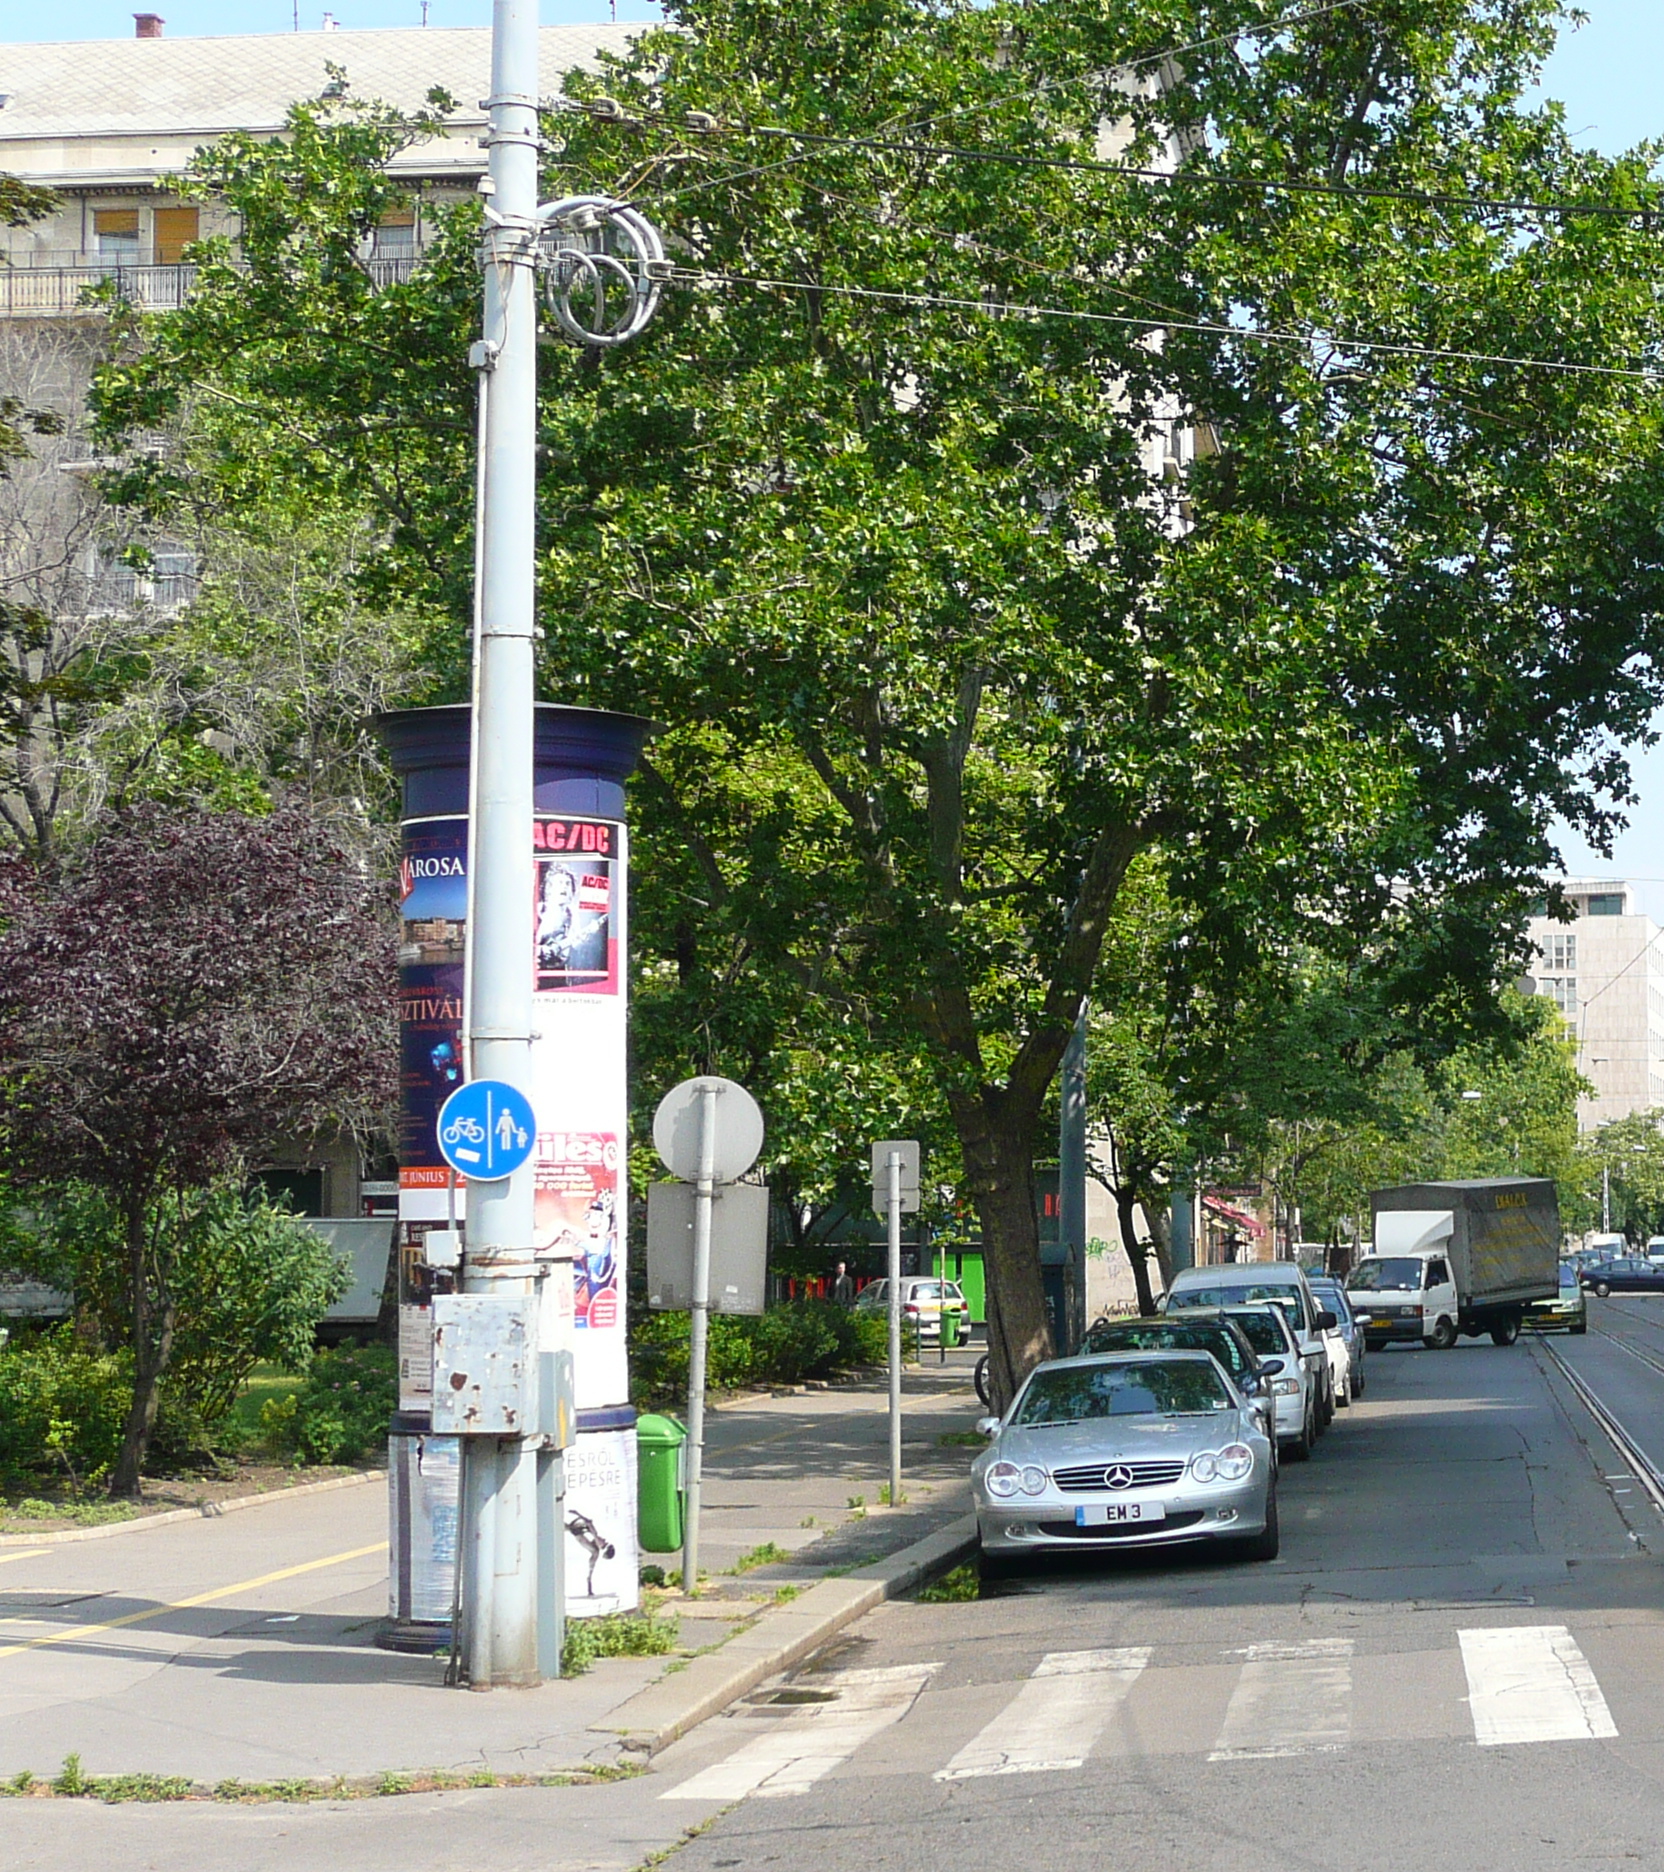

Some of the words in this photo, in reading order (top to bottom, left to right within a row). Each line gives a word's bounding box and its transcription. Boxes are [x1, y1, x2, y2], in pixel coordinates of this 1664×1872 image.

[533, 821, 609, 853] AC/DC
[581, 875, 608, 890] AC/DC
[409, 1169, 444, 1185] JÚNIUS
[567, 1469, 621, 1489] ÉPÉSRE
[1107, 1505, 1127, 1521] EM
[1131, 1504, 1141, 1519] 3
